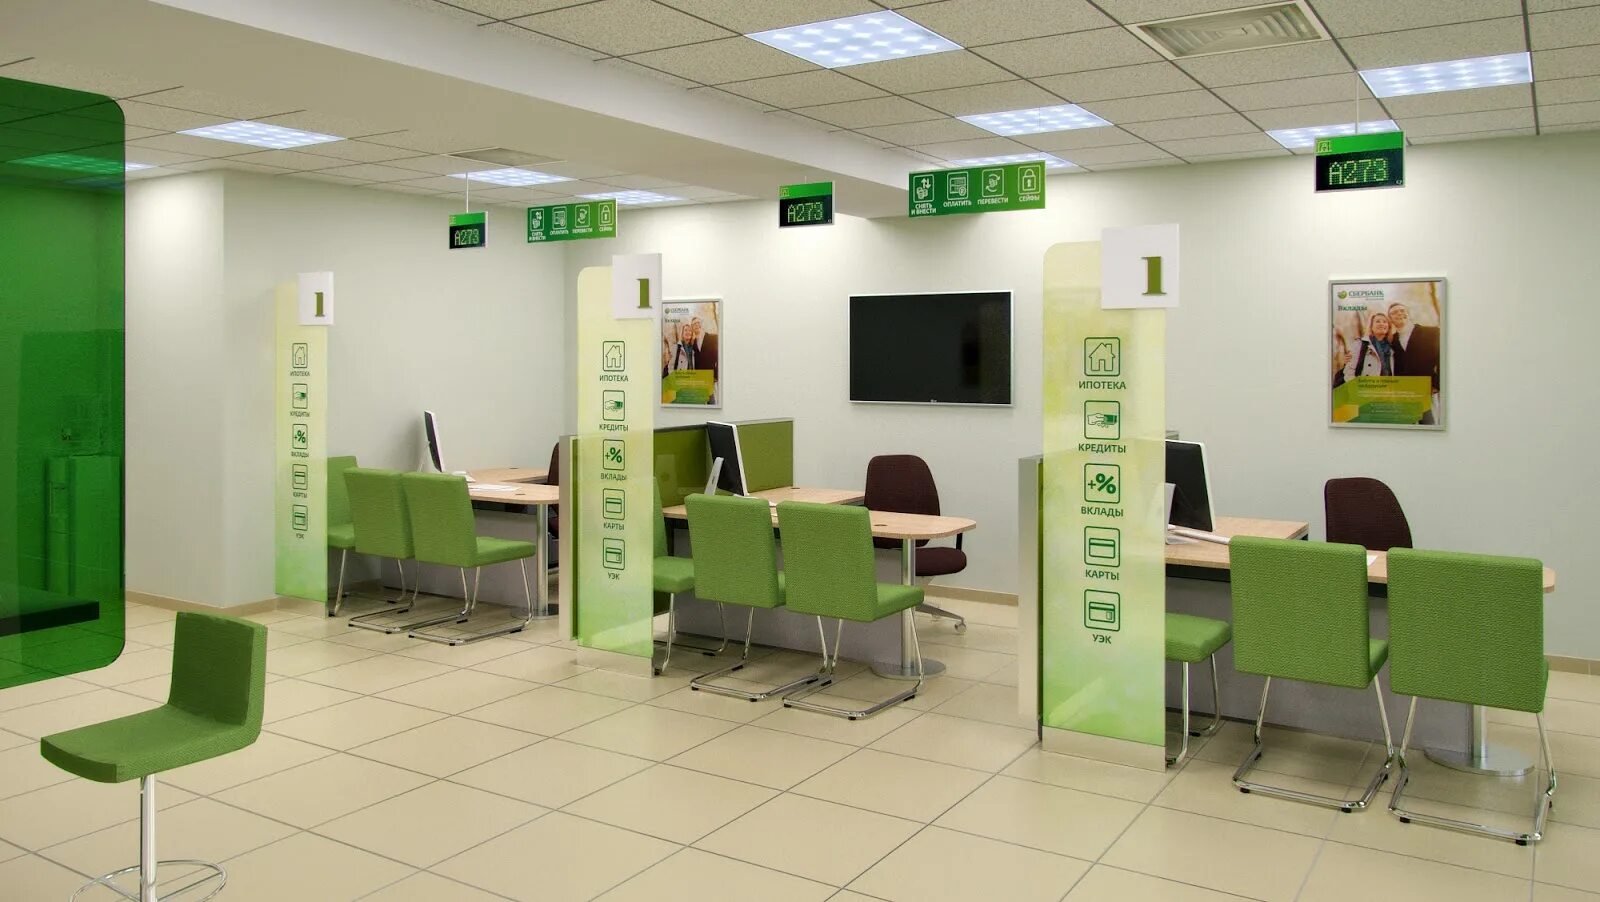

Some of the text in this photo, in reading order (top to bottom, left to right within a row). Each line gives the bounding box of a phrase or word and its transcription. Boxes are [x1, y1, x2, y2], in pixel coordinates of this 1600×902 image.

[977, 197, 1009, 205] ПЕРЕВЕСТИ
[1018, 194, 1040, 202] СЕЙФЫ
[943, 200, 972, 208] ОПЛАТИТЬ
[1141, 256, 1167, 296] 1
[636, 278, 652, 309] 1
[314, 291, 325, 318] 1
[599, 374, 629, 382] ИПОТЕКА
[1078, 380, 1127, 390] ИПОТЕКА
[290, 410, 310, 418] КРЕДИТЫ
[599, 423, 629, 432] КРЕДИТЫ
[1078, 443, 1126, 453] КРЕДИТЫ
[600, 472, 627, 481] ВКЛАДЫ
[1081, 506, 1124, 518] ВКЛАДЫ
[603, 522, 625, 531] КАРТЫ
[607, 572, 620, 580] УЭК
[1085, 569, 1120, 581] КАРТЫ
[1092, 633, 1112, 644] УЭК
